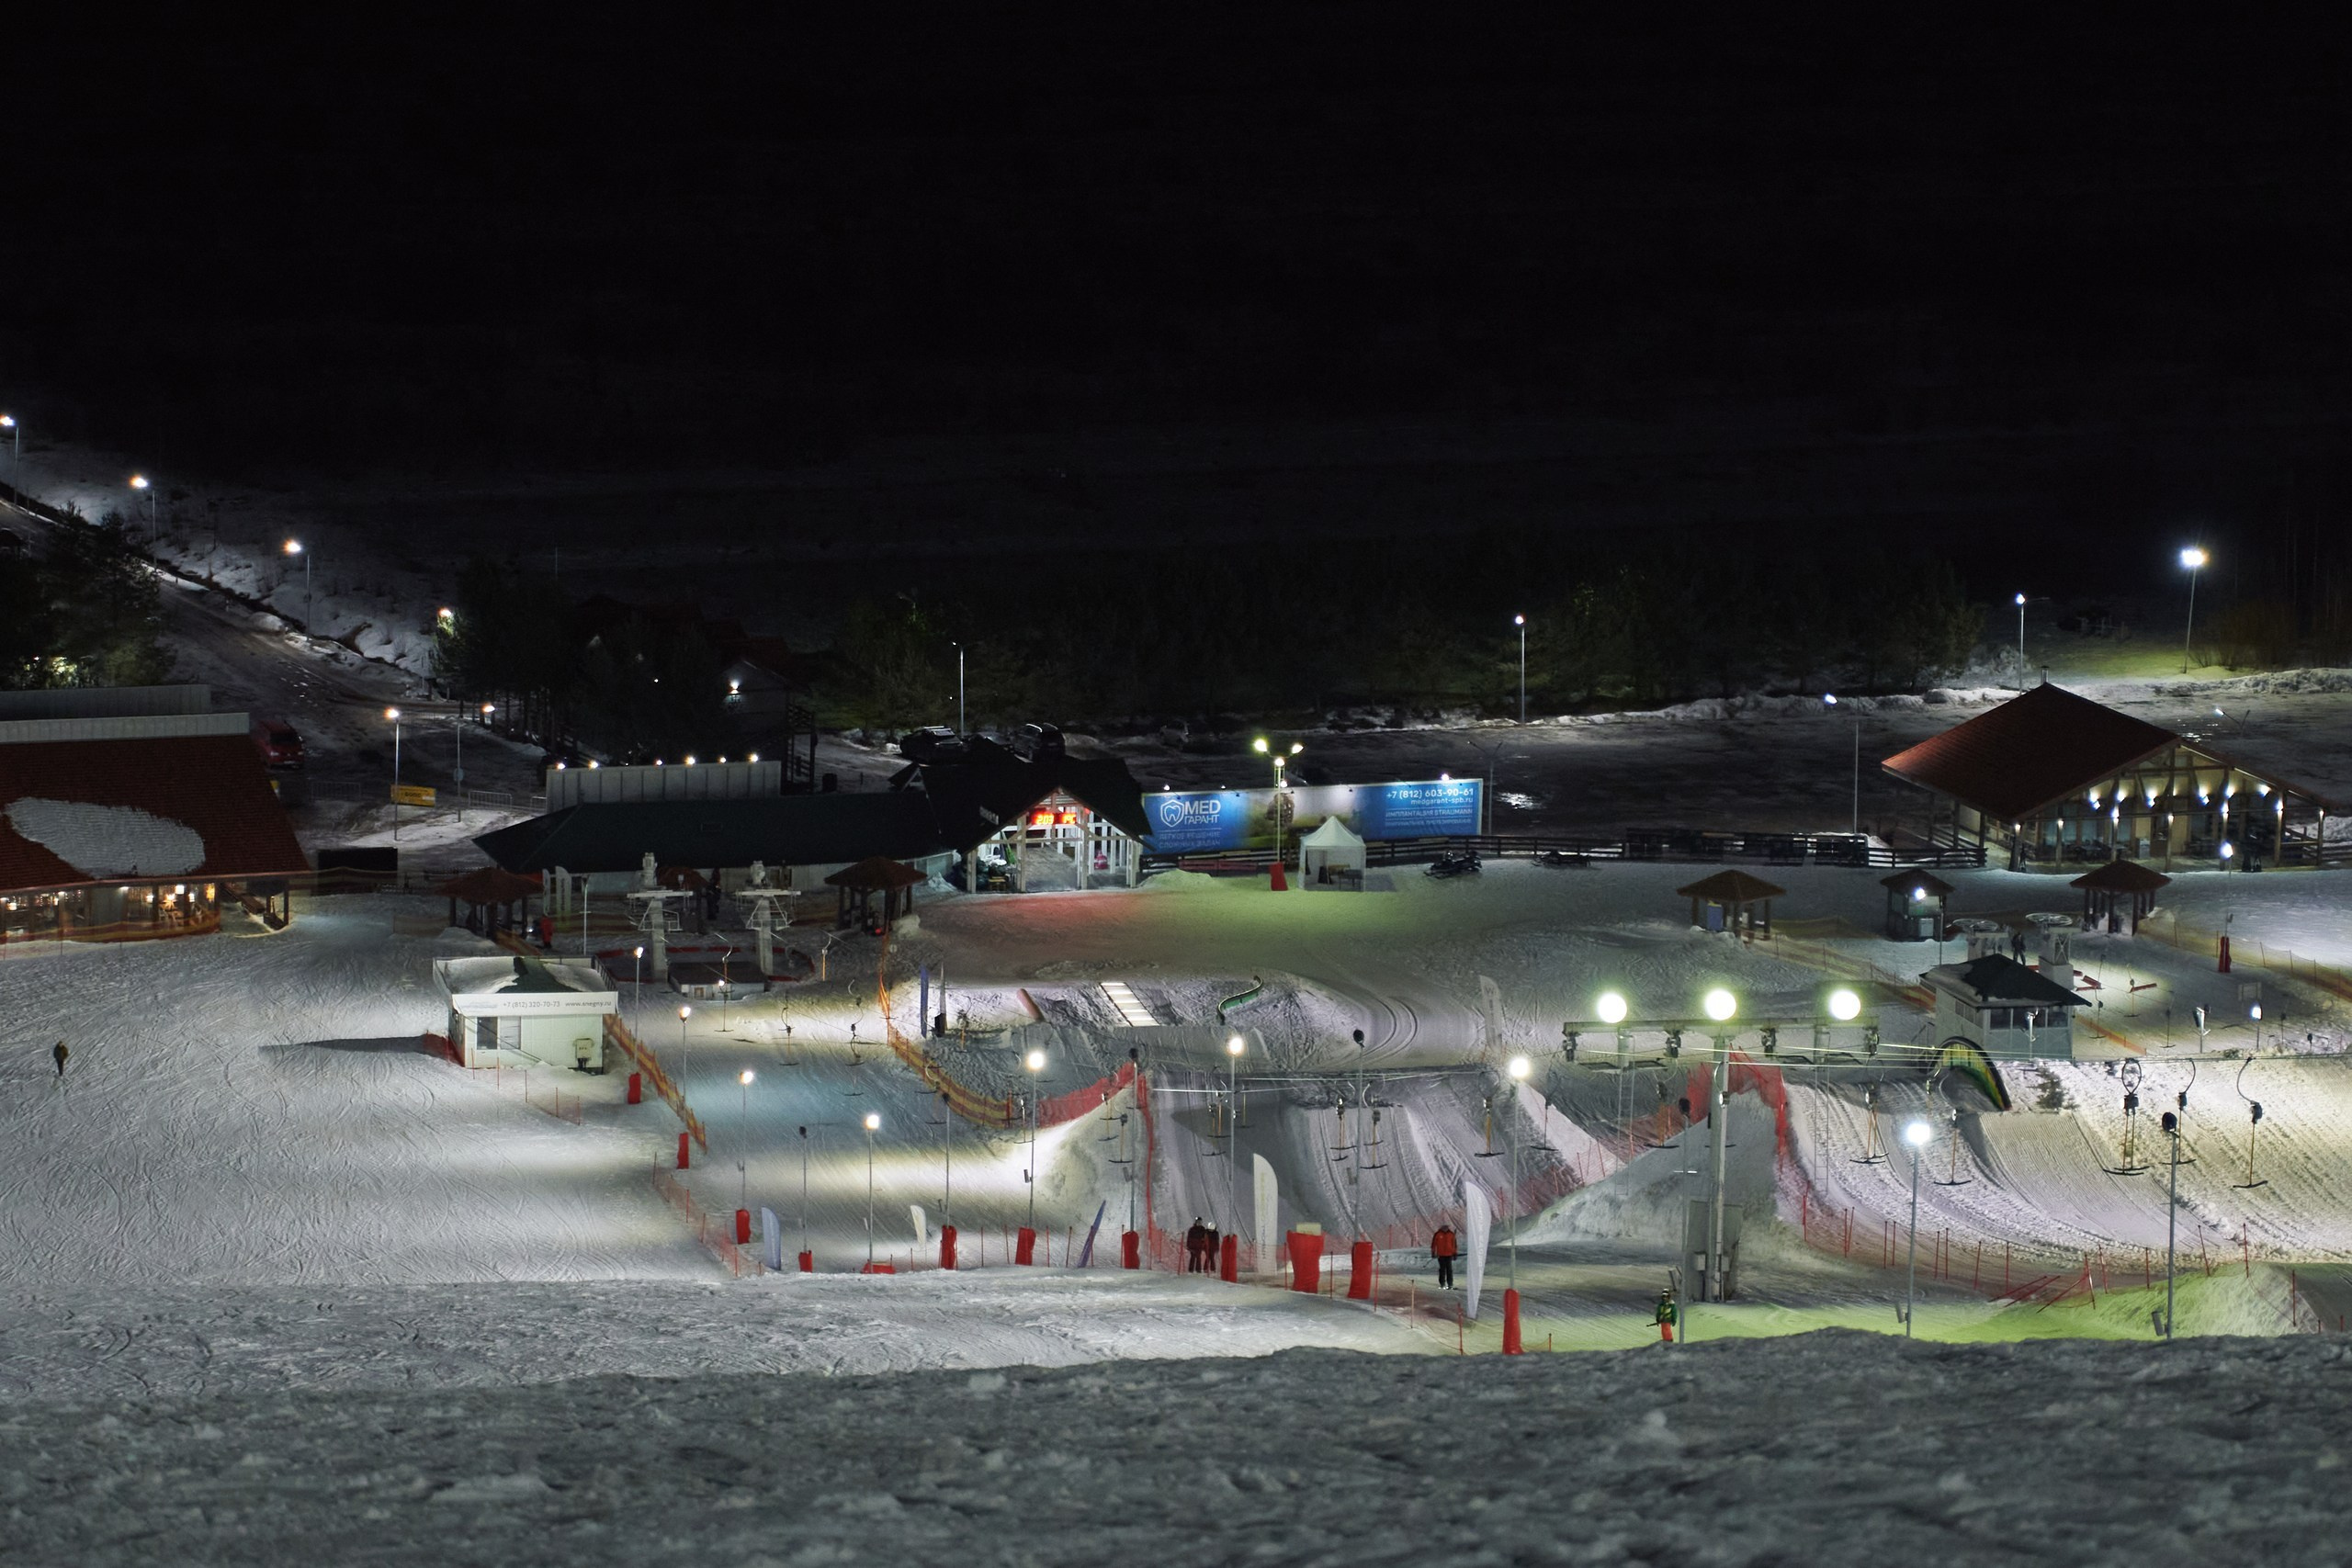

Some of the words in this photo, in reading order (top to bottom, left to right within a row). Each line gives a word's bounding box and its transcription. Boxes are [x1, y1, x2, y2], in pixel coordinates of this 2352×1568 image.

[1399, 790, 1422, 799] (812)
[1425, 788, 1474, 797] 603-90-61
[1411, 797, 1473, 806] medgarant-spb.ru
[1184, 800, 1221, 815] MED
[1184, 814, 1220, 824] ГАРАНТ
